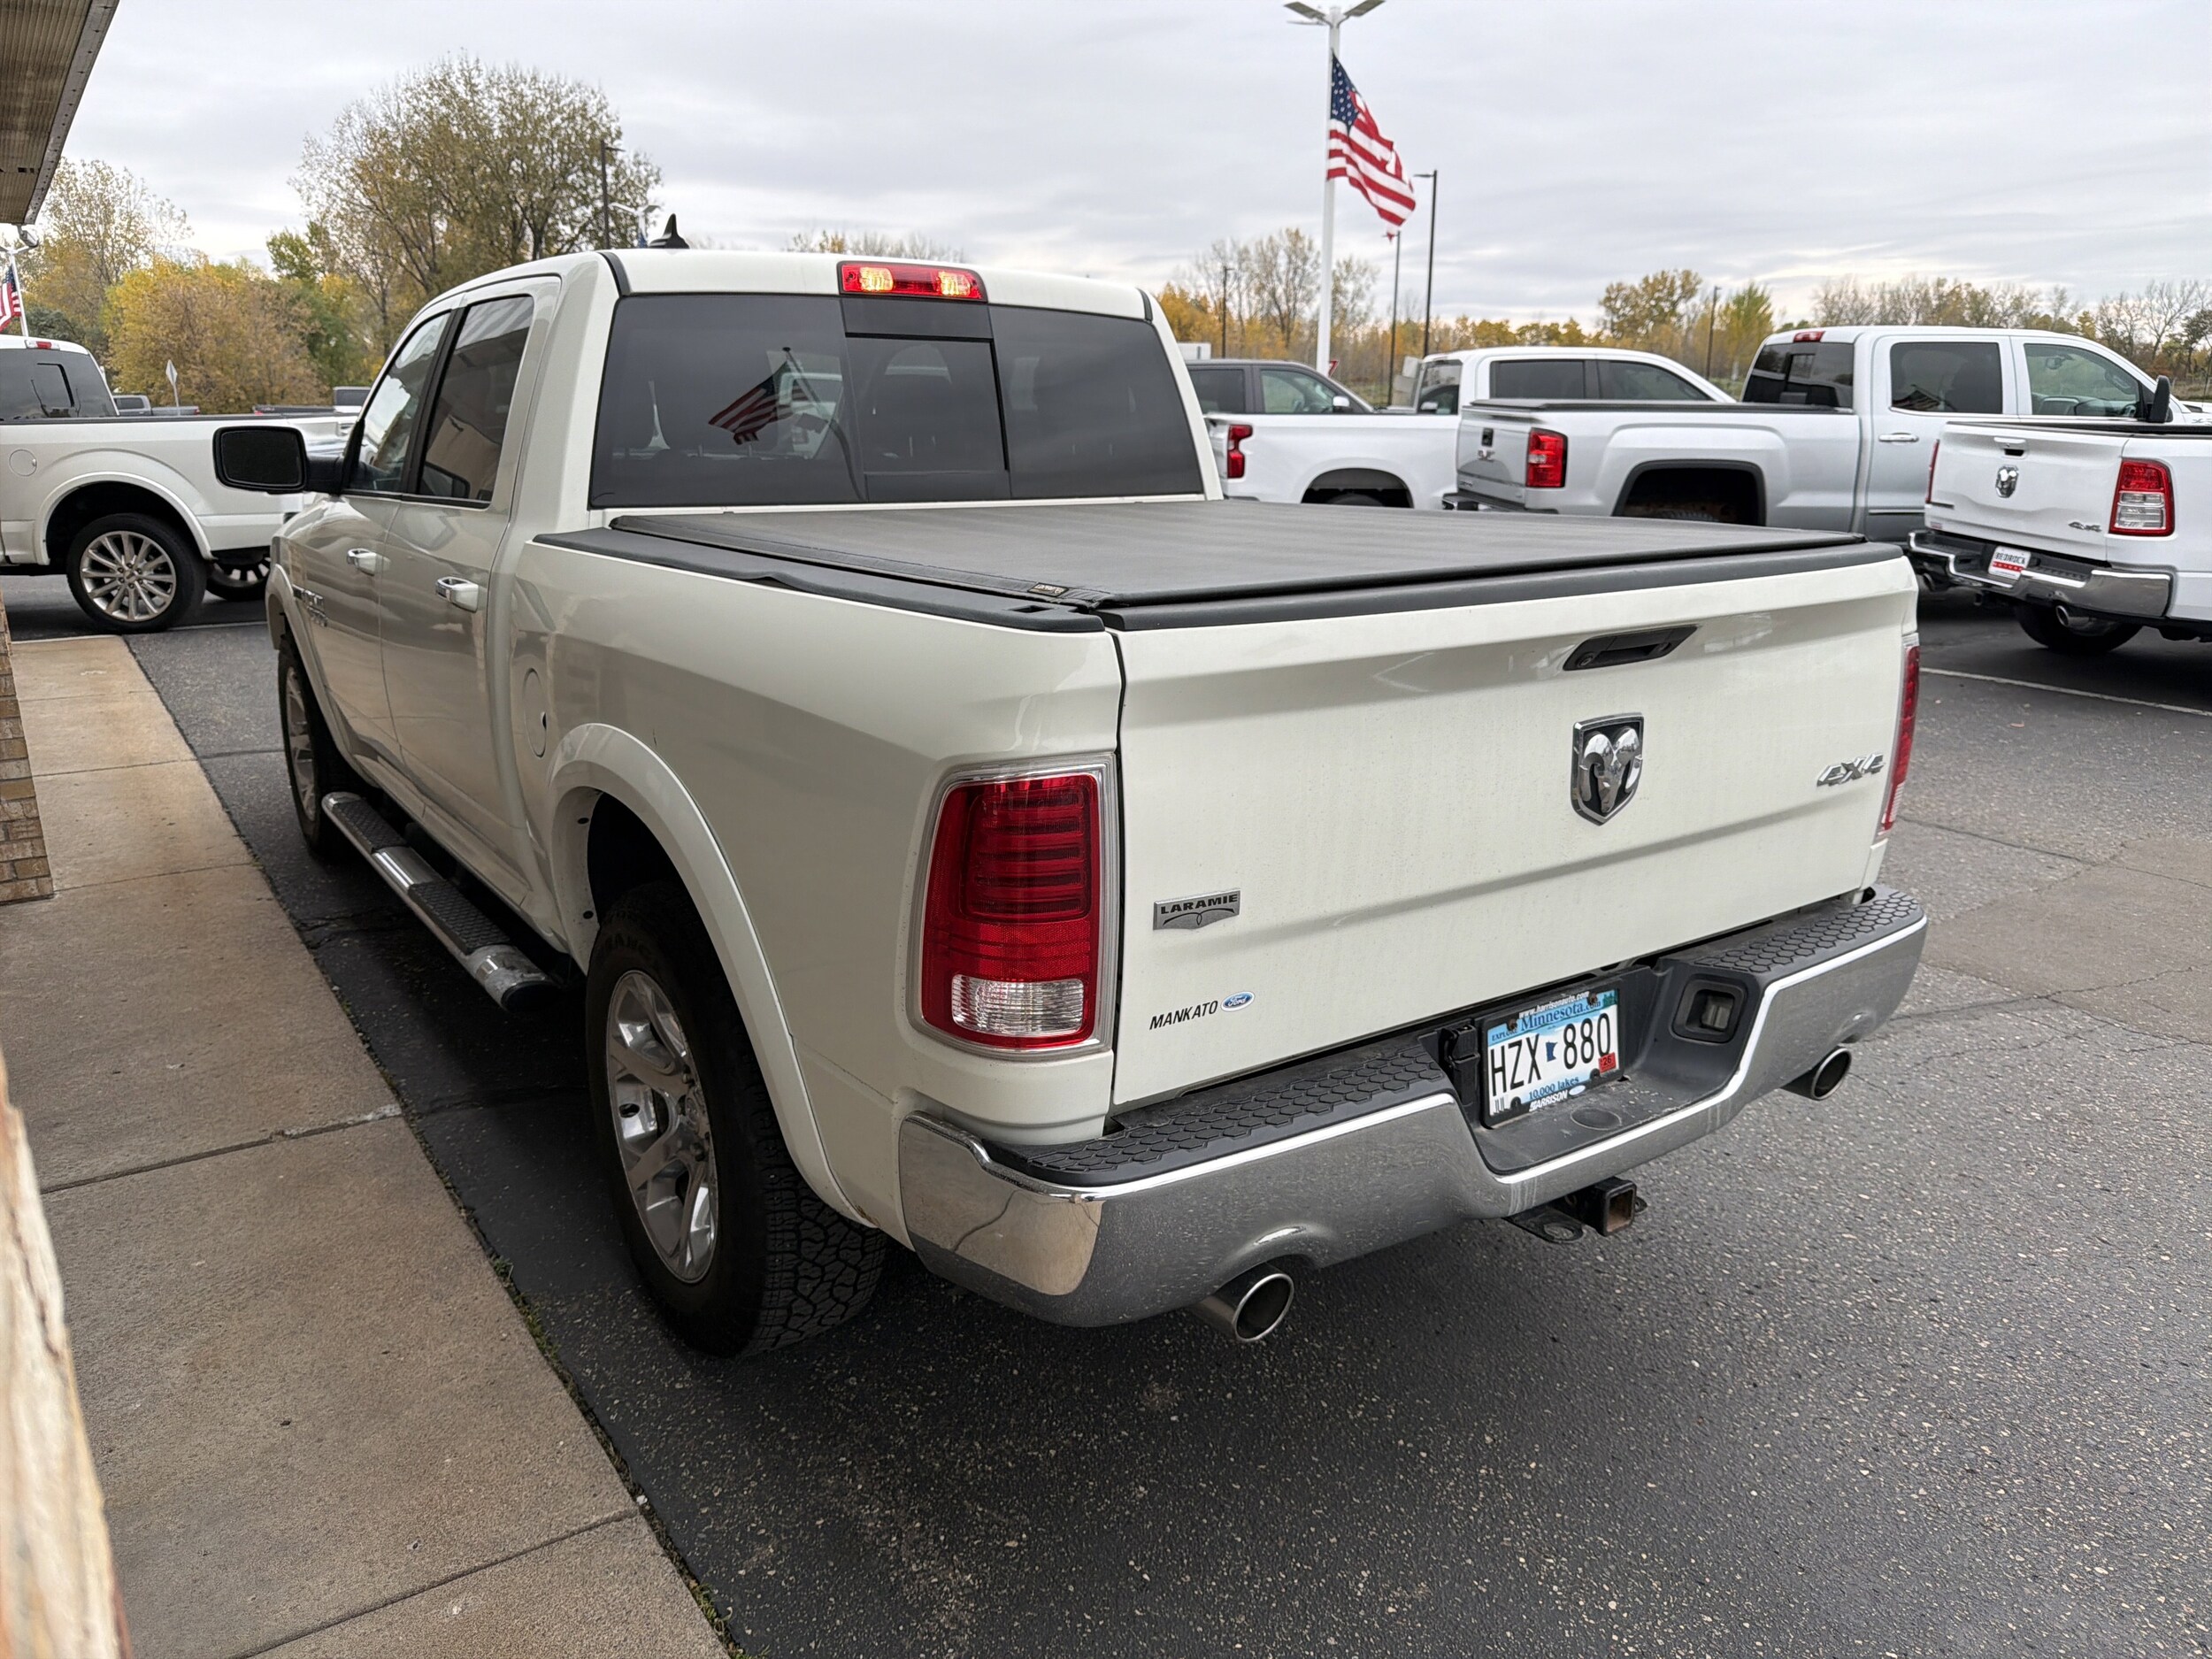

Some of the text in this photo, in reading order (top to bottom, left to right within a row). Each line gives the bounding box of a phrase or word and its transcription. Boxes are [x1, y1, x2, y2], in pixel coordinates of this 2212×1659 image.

[1161, 894, 1238, 914] LARAMIE
[1149, 995, 1248, 1030] MANKATO Ford
[1490, 1012, 1610, 1096] HZX 880
[1557, 1077, 1579, 1091] lakes
